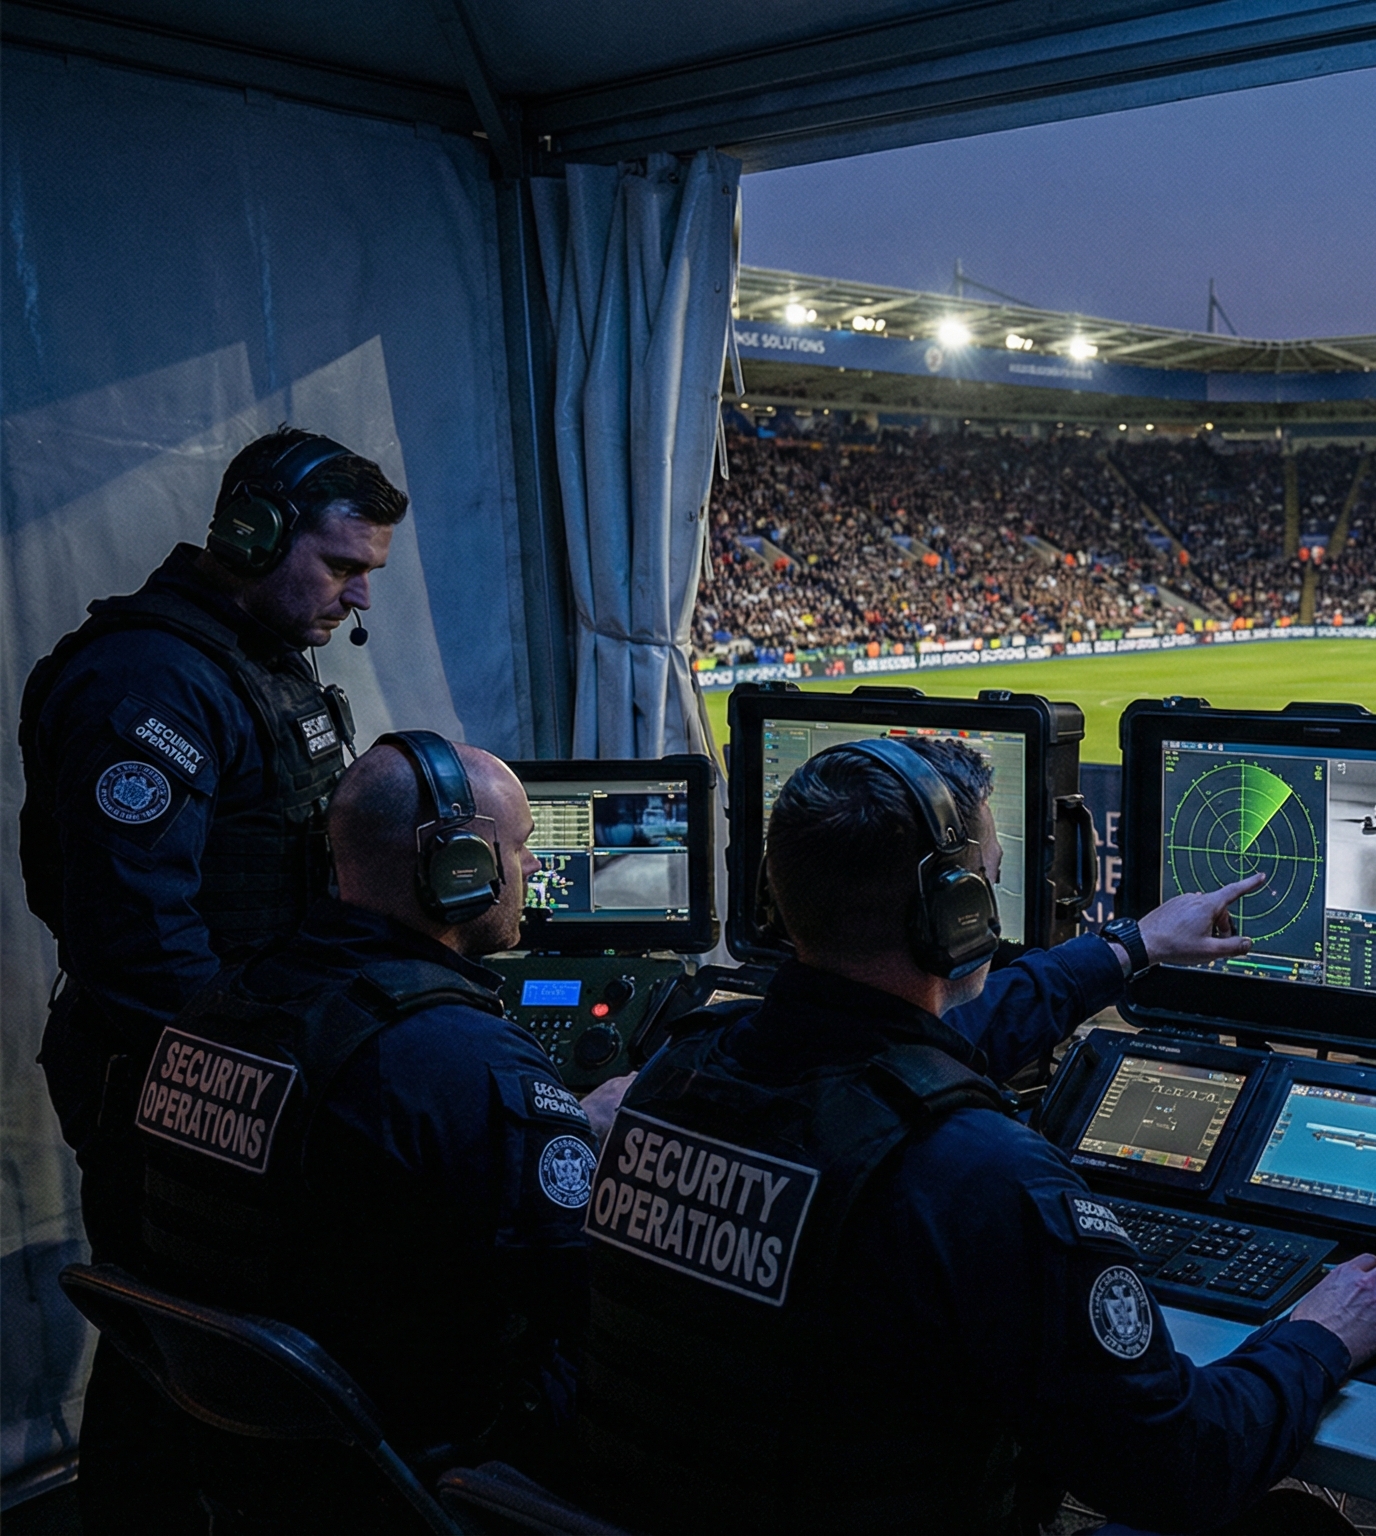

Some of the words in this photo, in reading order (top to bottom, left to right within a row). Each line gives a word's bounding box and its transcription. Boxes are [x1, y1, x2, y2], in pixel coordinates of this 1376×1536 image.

[762, 333, 825, 353] SOLUTIONS
[161, 1041, 274, 1107] SECURITY
[142, 1081, 266, 1159] OPERATIONS
[617, 1127, 790, 1224] SECURITY
[595, 1177, 782, 1287] OPERATIONS
